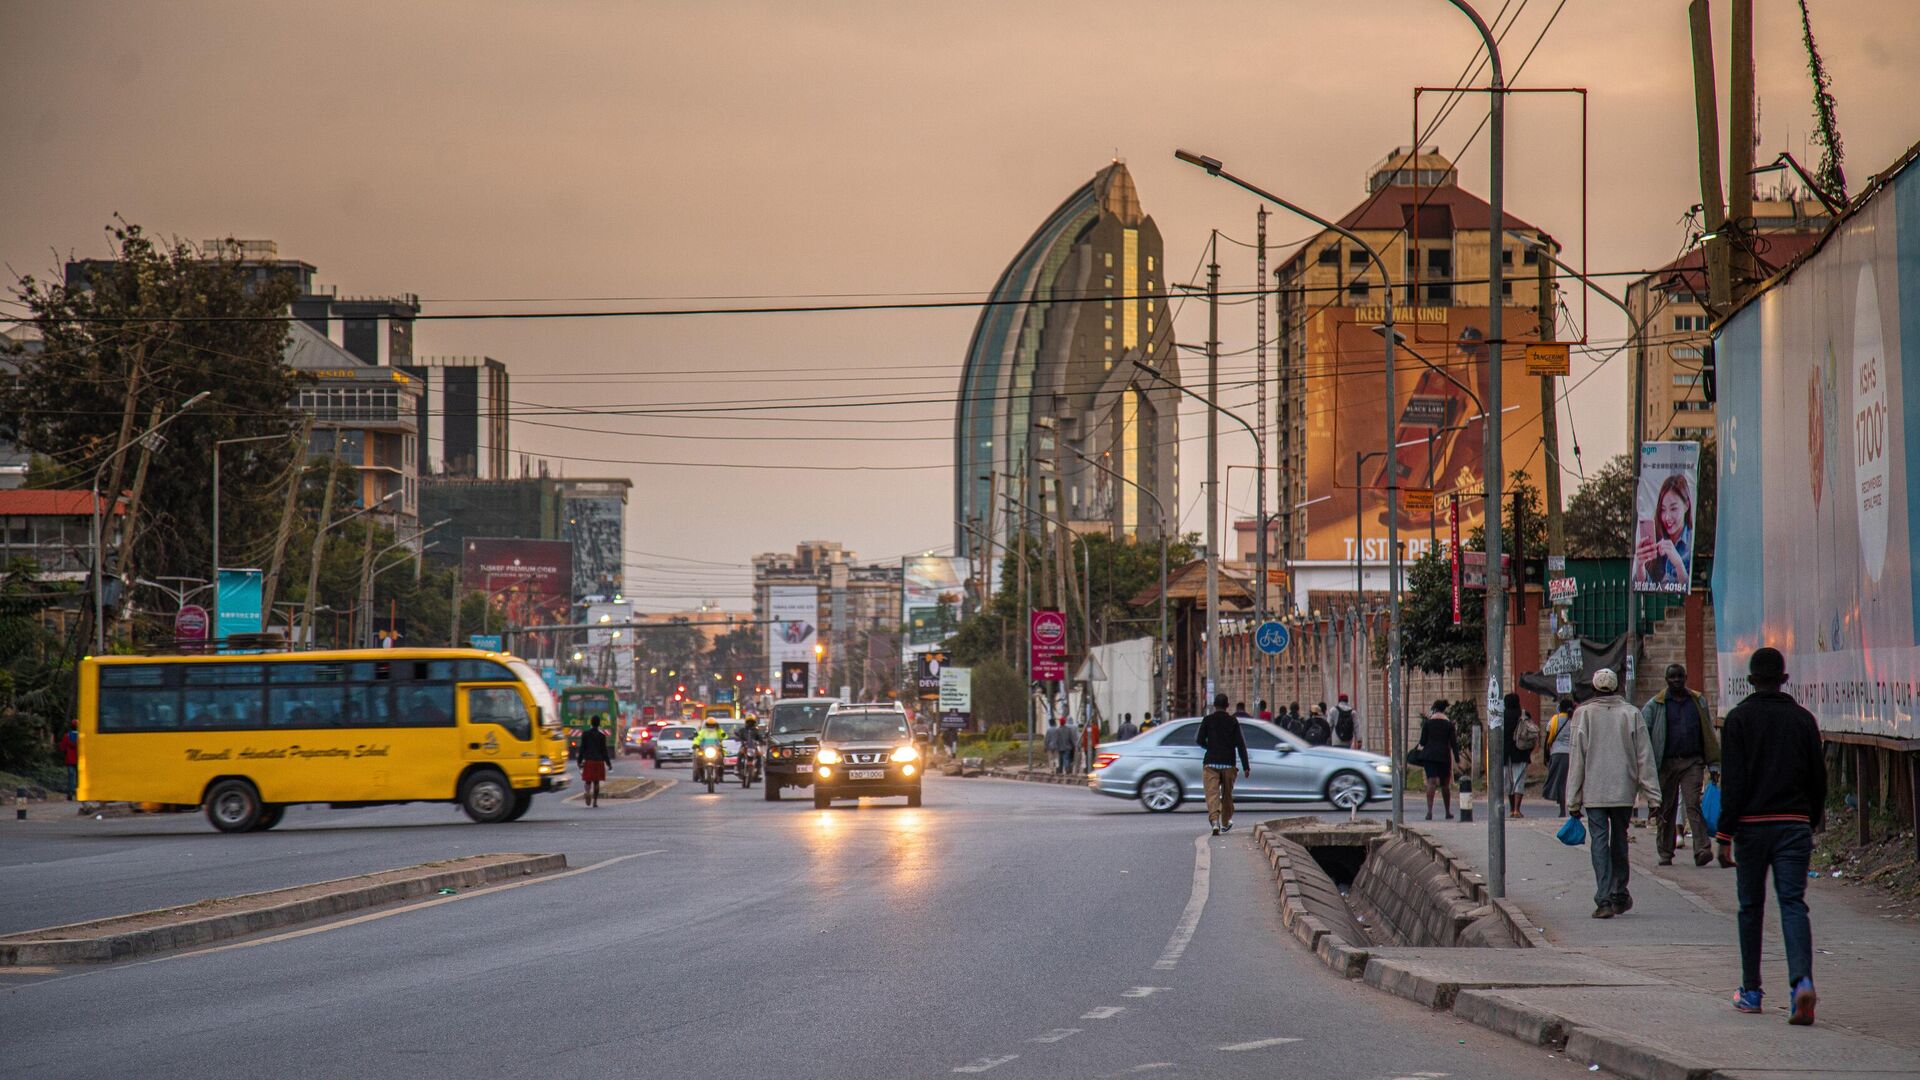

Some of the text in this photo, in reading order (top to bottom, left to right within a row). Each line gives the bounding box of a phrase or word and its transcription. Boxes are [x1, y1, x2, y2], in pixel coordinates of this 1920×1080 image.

[1859, 357, 1876, 395] KSHS
[1842, 681, 1875, 705] HARMFUL
[1876, 682, 1887, 707] TO
[1890, 683, 1912, 707] YOUR
